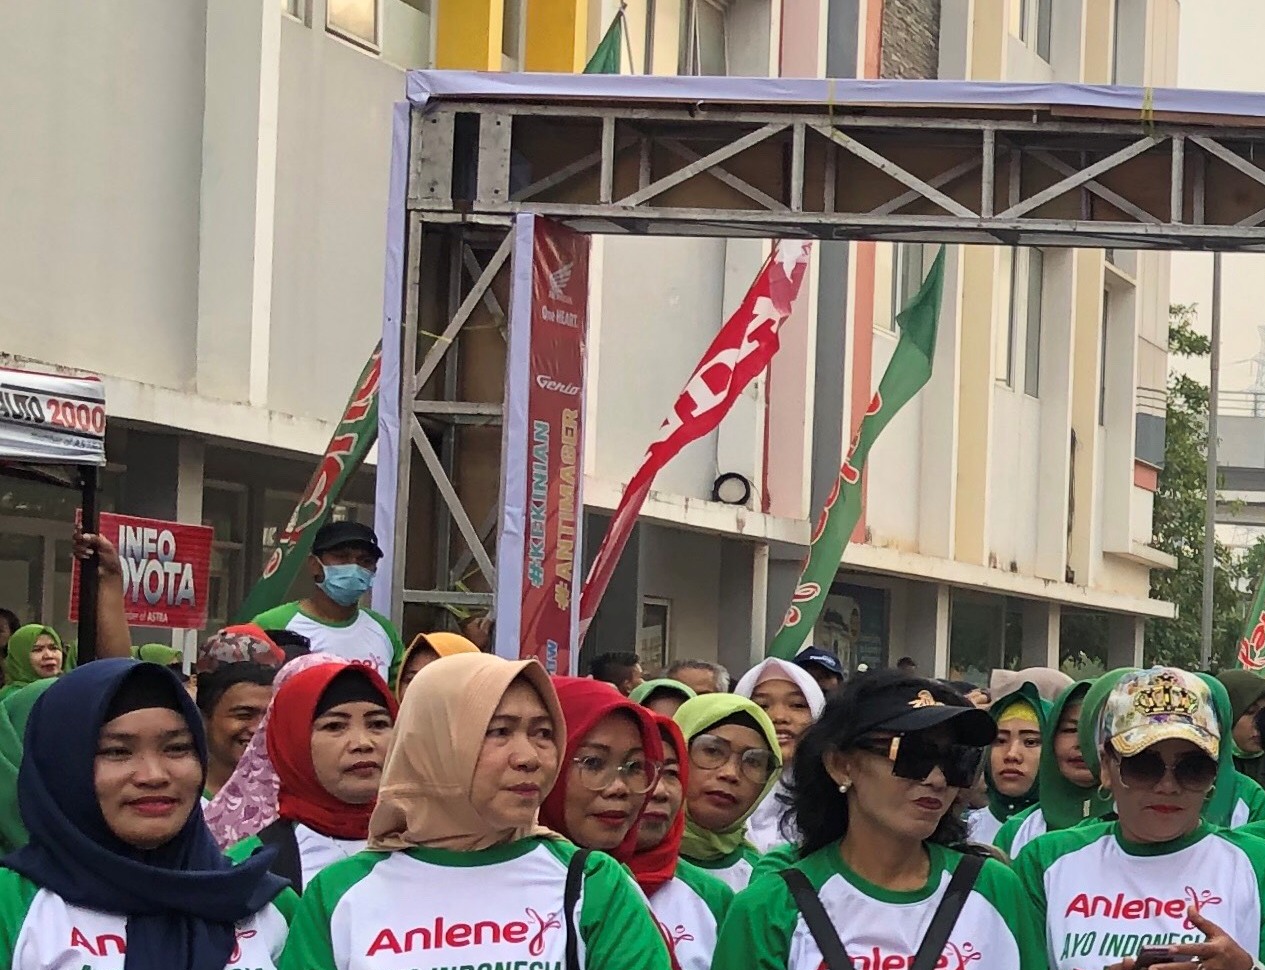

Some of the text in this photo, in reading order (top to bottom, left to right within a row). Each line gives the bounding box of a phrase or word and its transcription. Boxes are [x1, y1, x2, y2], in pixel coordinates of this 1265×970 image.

[536, 374, 580, 396] Genio
[47, 399, 105, 434] 2000
[528, 419, 550, 588] #KEKINIAN
[119, 525, 176, 562] INFO
[1065, 892, 1187, 920] Anlene
[366, 916, 529, 957] Anlene
[1061, 931, 1097, 961] AYO
